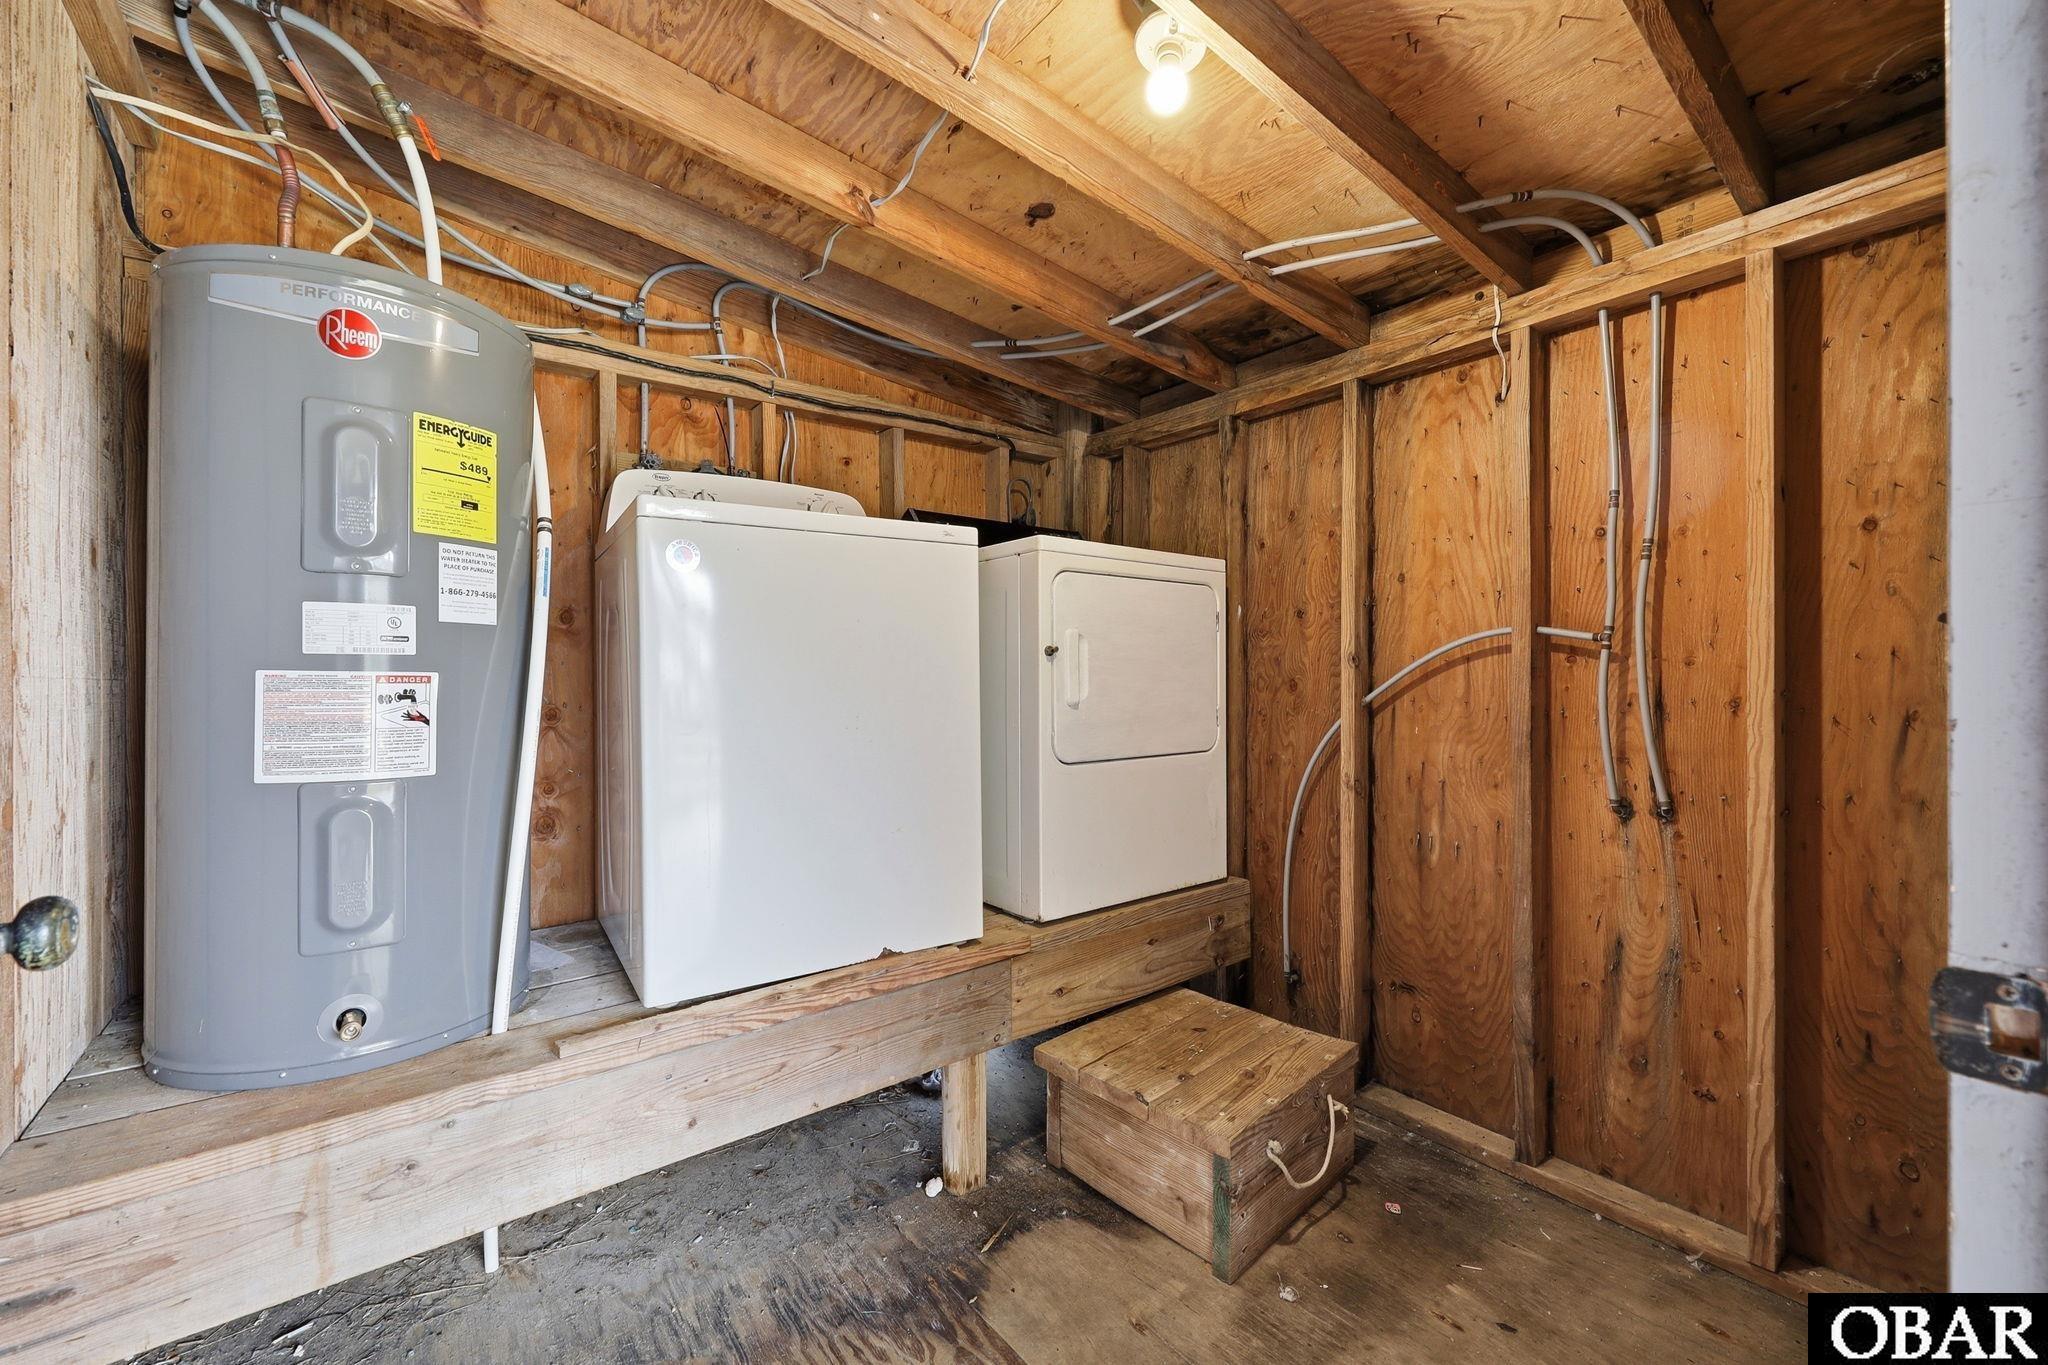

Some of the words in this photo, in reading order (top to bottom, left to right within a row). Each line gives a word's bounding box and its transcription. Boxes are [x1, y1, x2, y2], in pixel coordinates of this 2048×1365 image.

[280, 281, 422, 321] PERFORMANCE
[326, 309, 378, 351] Rheem
[419, 418, 493, 448] ENERGYGUIDE
[460, 461, 488, 476] $489
[443, 563, 461, 571] PLACE
